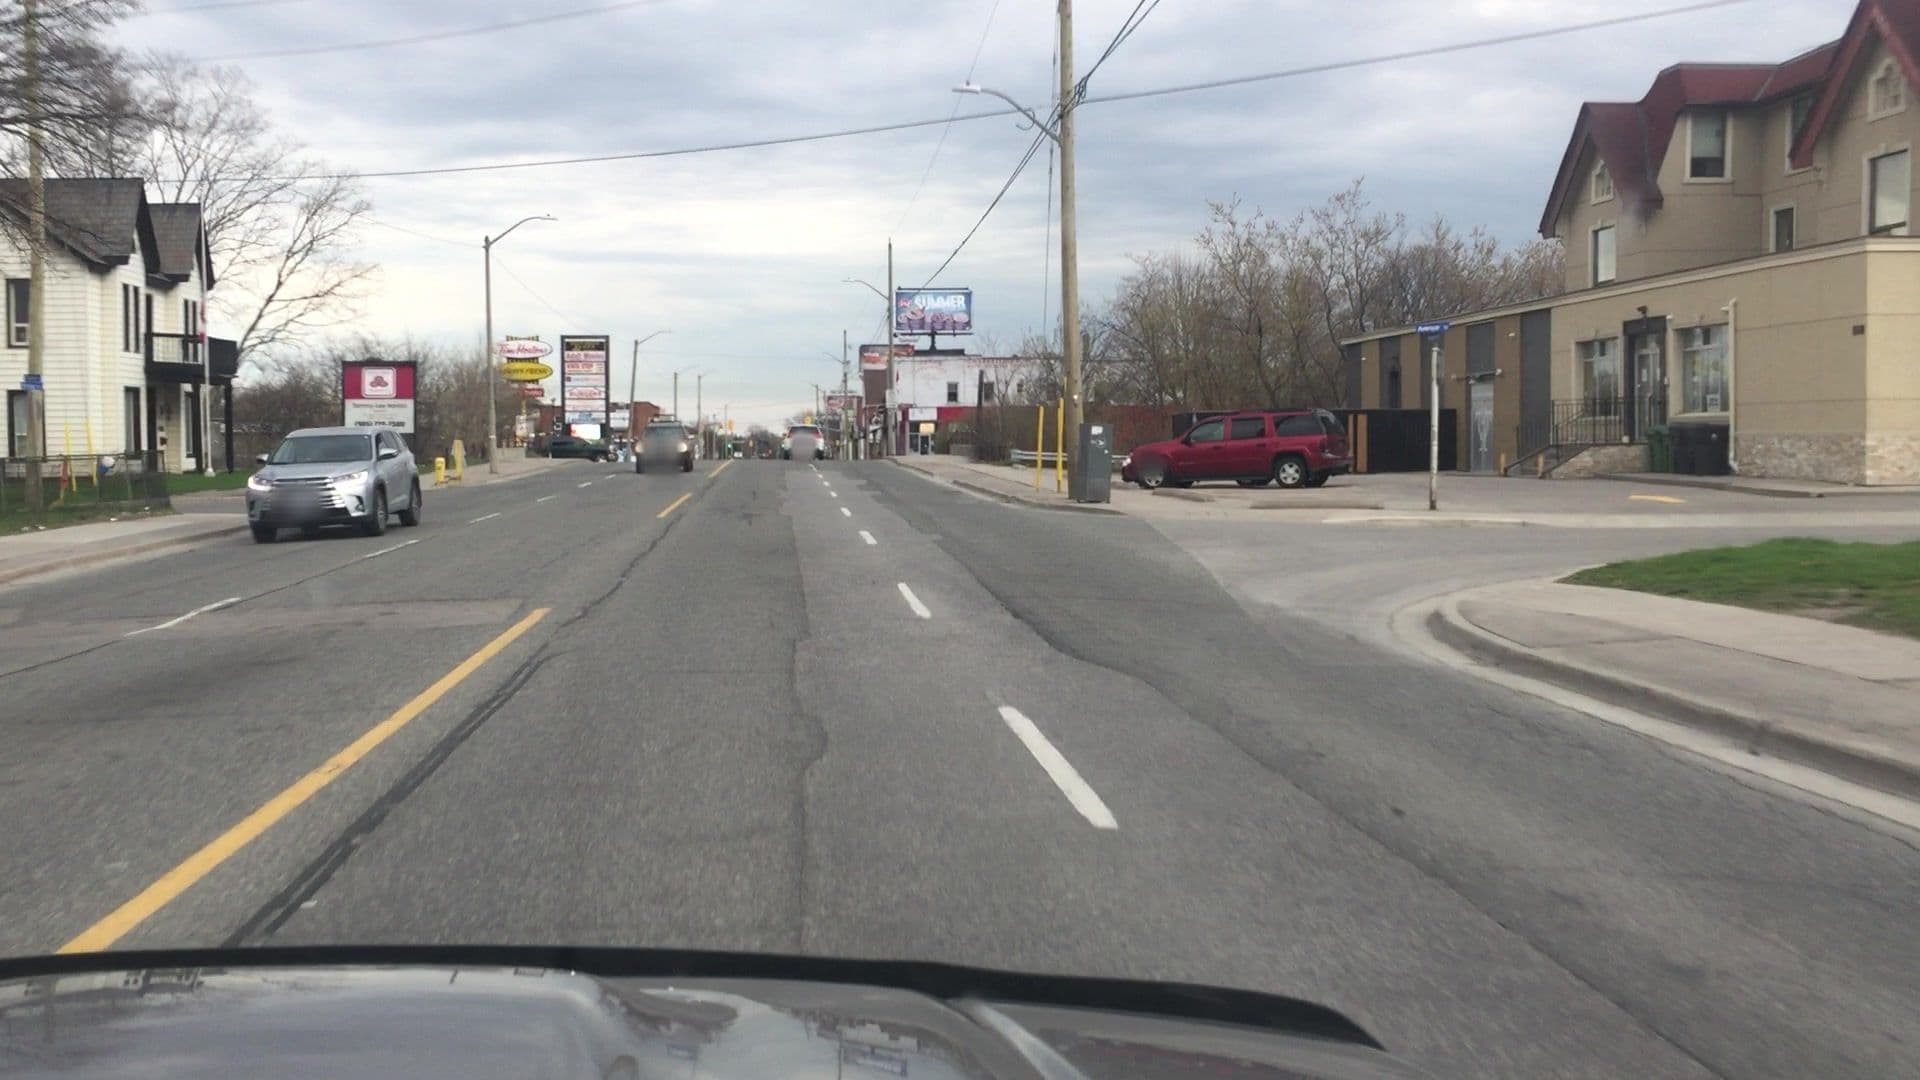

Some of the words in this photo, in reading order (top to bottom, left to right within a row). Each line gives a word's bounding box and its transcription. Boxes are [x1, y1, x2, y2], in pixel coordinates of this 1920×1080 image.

[914, 294, 966, 309] SUMMER
[498, 343, 513, 354] Tim
[514, 342, 546, 355] Hortons
